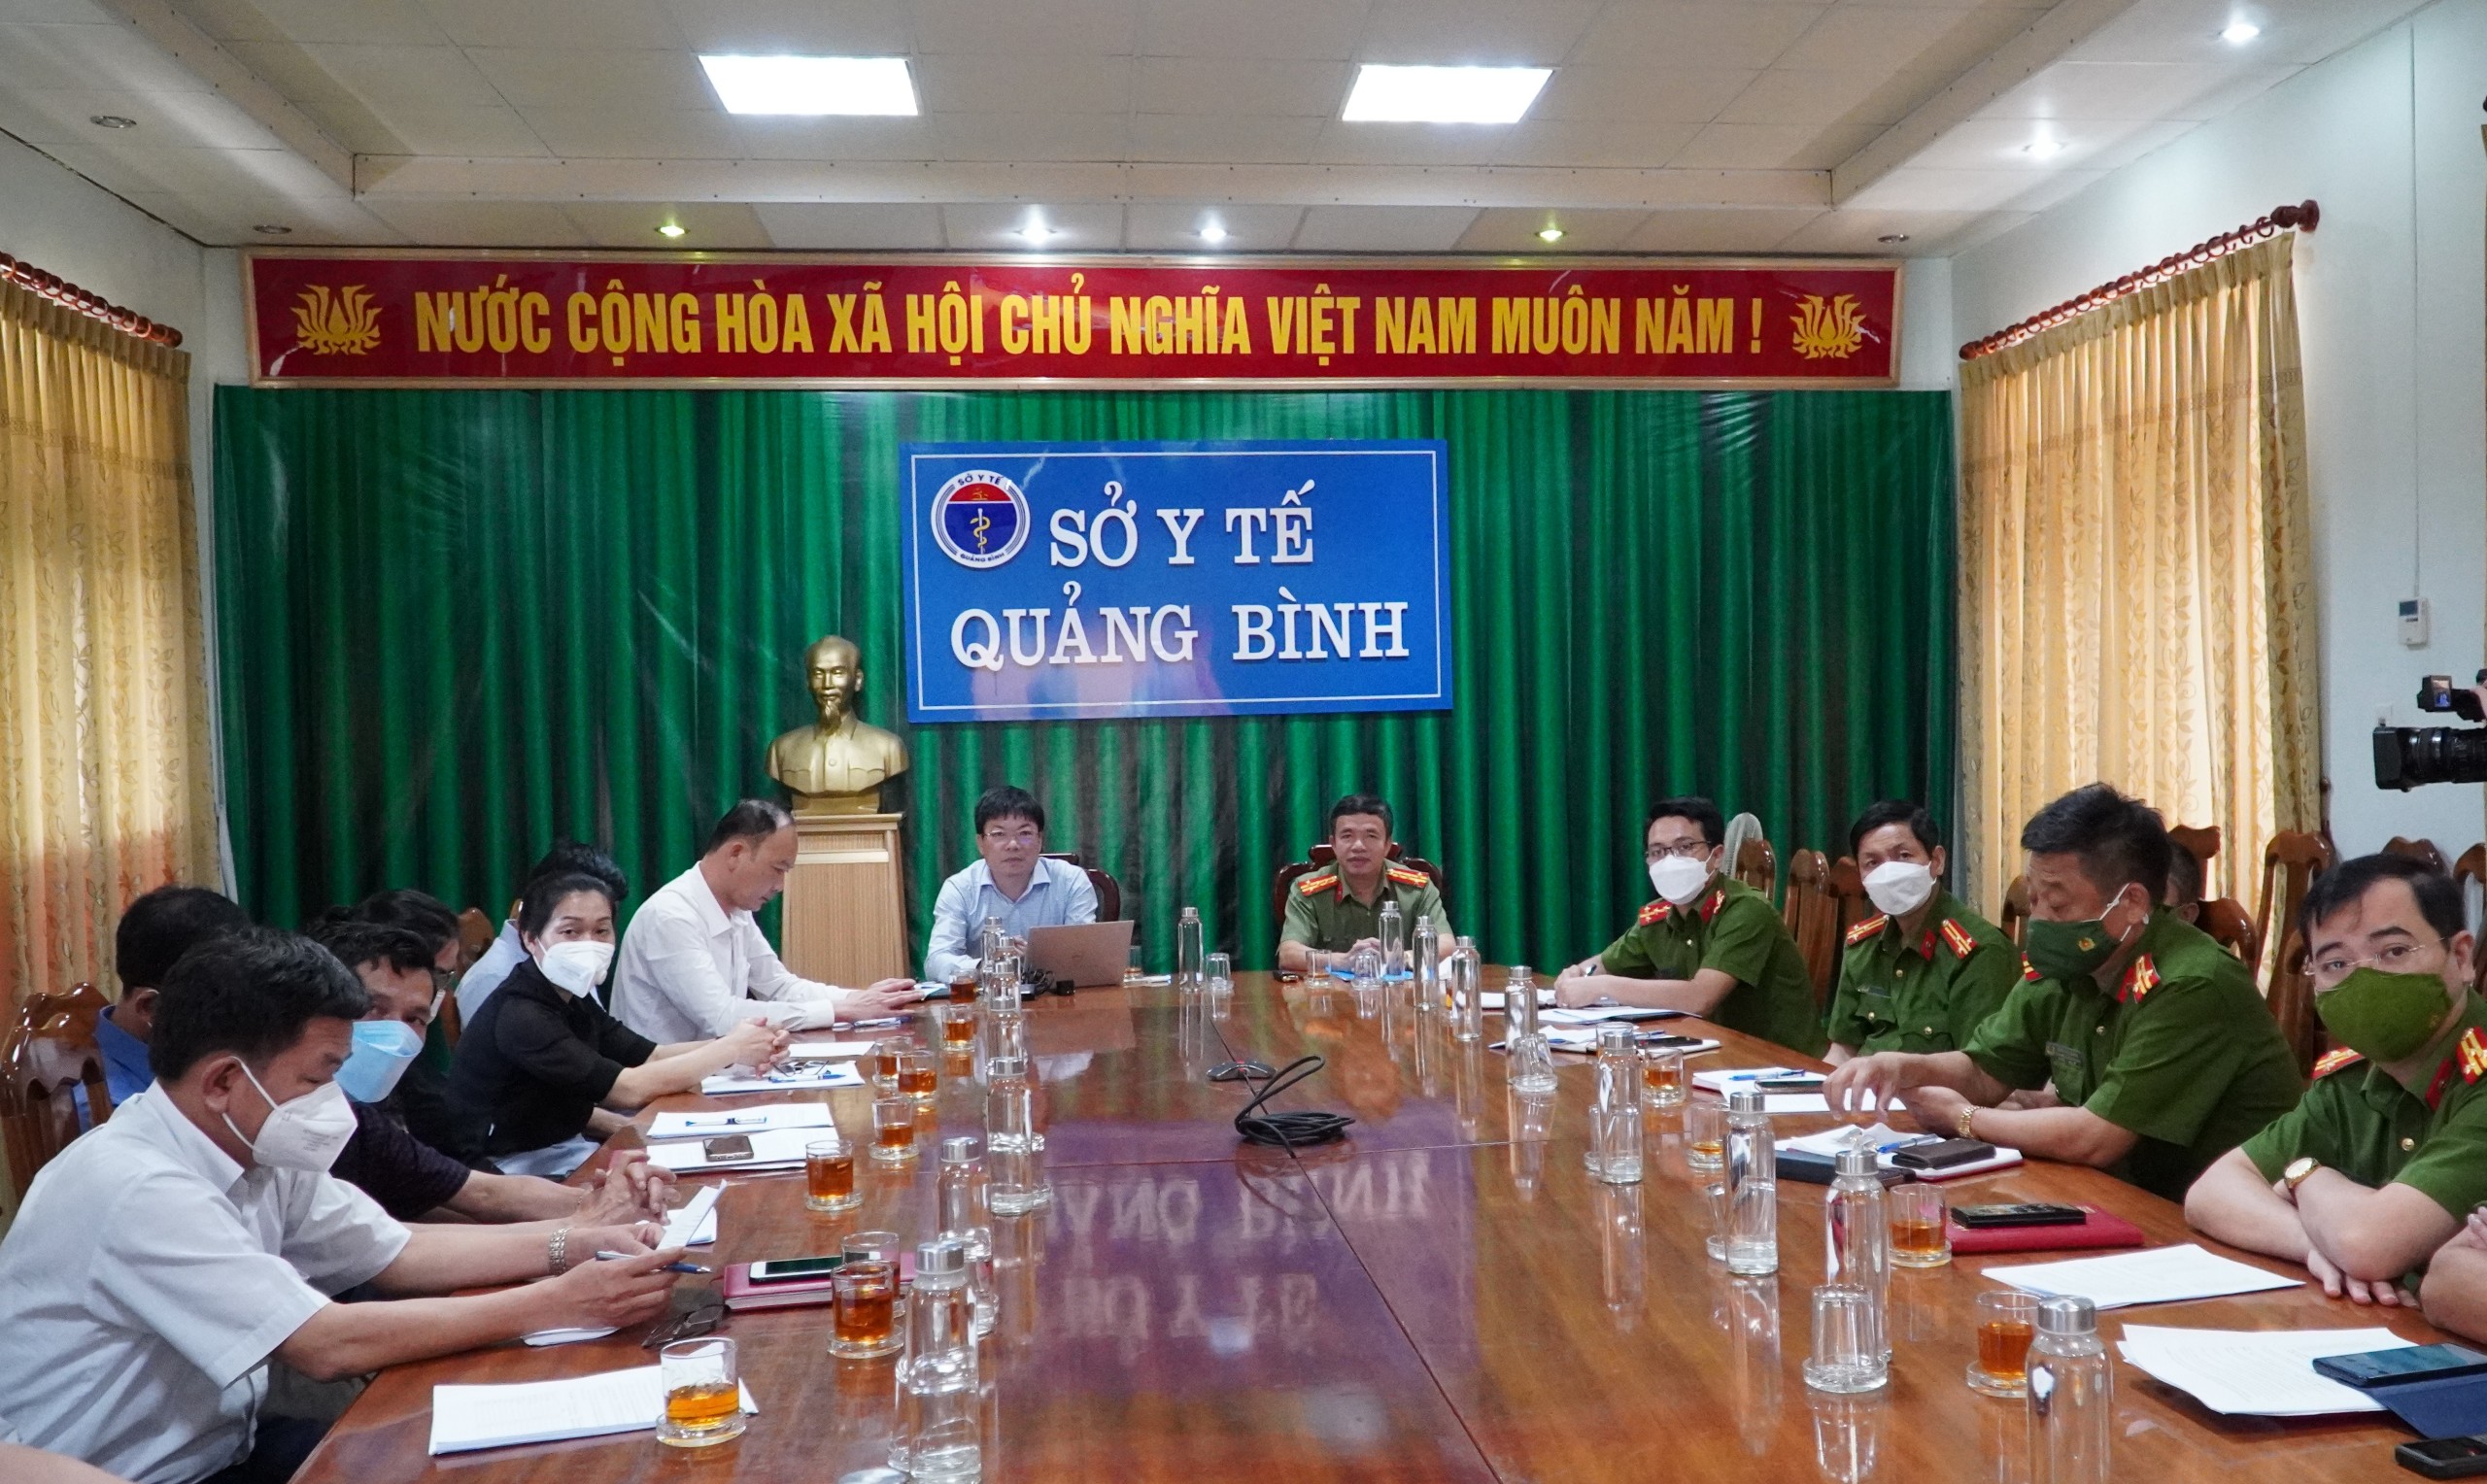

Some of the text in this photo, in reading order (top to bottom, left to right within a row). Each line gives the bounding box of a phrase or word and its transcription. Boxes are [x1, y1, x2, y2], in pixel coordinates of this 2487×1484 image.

[415, 272, 1762, 366] NƯỚC CỘNG HÒA XÃ HỘI CHỦ NGHĨA VIỆT NAM MUÔN NĂM !
[1049, 479, 1315, 568] SỞ Y TẾ
[950, 580, 1410, 672] QUẢNG BÌNH
